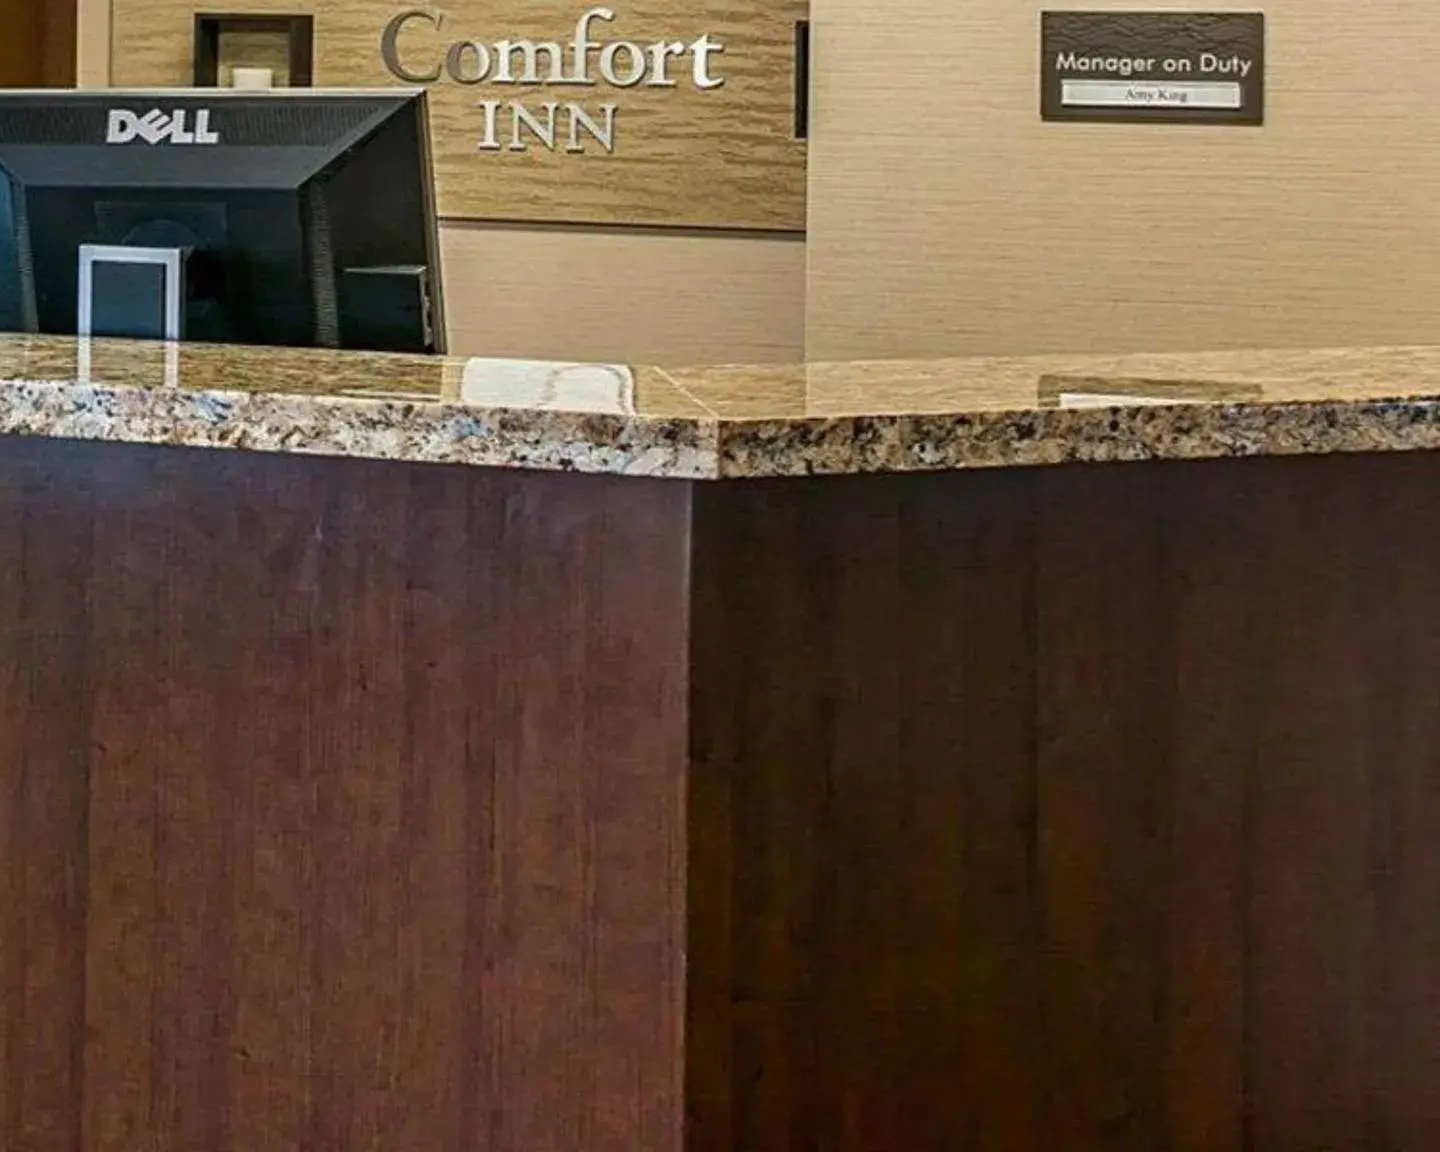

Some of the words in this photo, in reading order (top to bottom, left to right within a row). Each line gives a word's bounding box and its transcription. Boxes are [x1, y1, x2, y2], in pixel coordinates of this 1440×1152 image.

[380, 7, 726, 90] Comfort
[1056, 51, 1156, 76] Manager
[1163, 60, 1192, 73] on
[1199, 52, 1252, 78] Duty
[1124, 88, 1155, 103] Amy
[1158, 89, 1189, 103] King
[106, 108, 220, 145] DELL
[479, 99, 618, 153] INN
